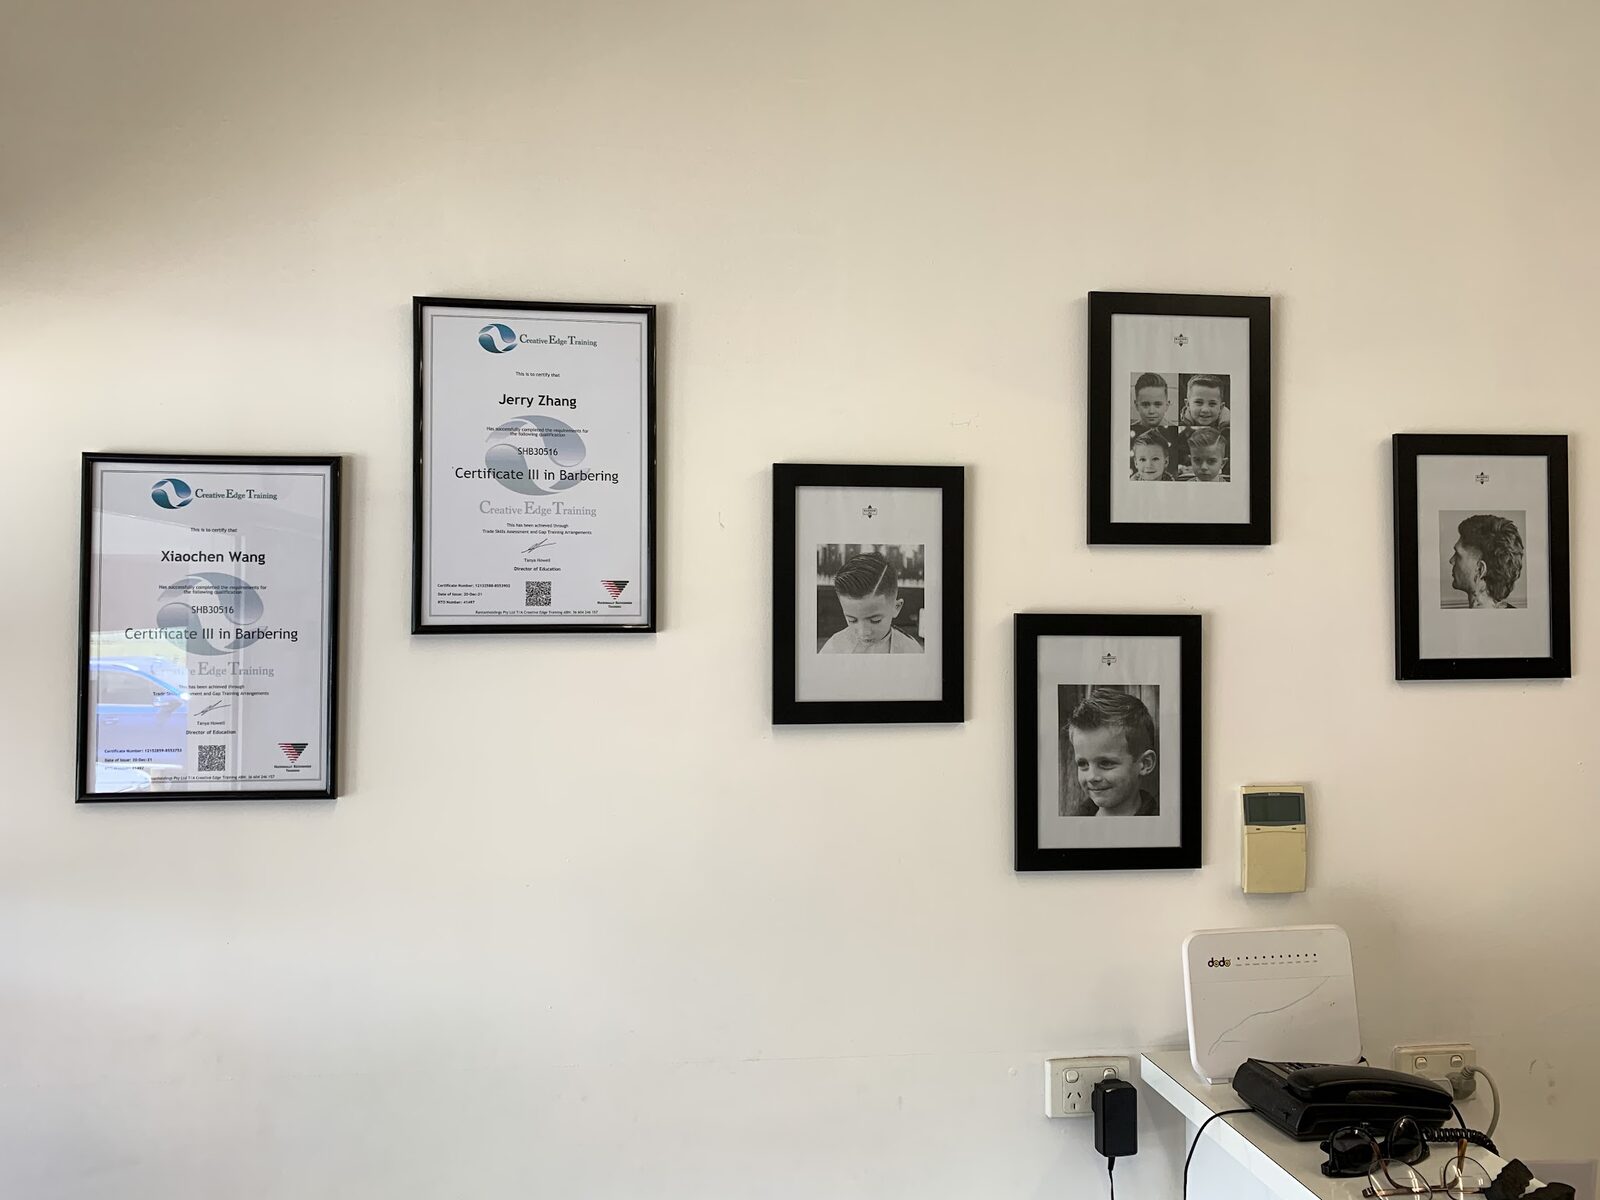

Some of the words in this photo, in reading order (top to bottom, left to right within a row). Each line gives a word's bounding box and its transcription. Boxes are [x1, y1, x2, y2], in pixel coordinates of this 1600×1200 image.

[519, 334, 548, 344] Creative
[549, 335, 567, 346] Edge
[568, 336, 598, 347] Training
[498, 394, 534, 408] Jerry
[538, 395, 577, 409] Zhang
[517, 447, 558, 456] SHB30516
[455, 467, 524, 480] Certificate
[528, 469, 539, 480] III
[544, 469, 555, 480] in
[559, 470, 618, 484] Barbering
[195, 488, 225, 499] Creative
[226, 489, 246, 500] Edge
[246, 489, 278, 500] Training
[479, 500, 522, 515] Creative
[524, 501, 552, 517] Edge
[552, 501, 597, 517] Training
[161, 550, 224, 562] Xiaochen
[228, 551, 266, 565] Wang
[191, 606, 234, 614] SHB30516
[124, 627, 198, 640] Certificate
[202, 628, 214, 640] III
[219, 628, 231, 640] in
[235, 628, 298, 642] Barbering
[198, 661, 227, 677] Edge
[227, 661, 274, 677] Training
[1208, 957, 1231, 967] dodo
